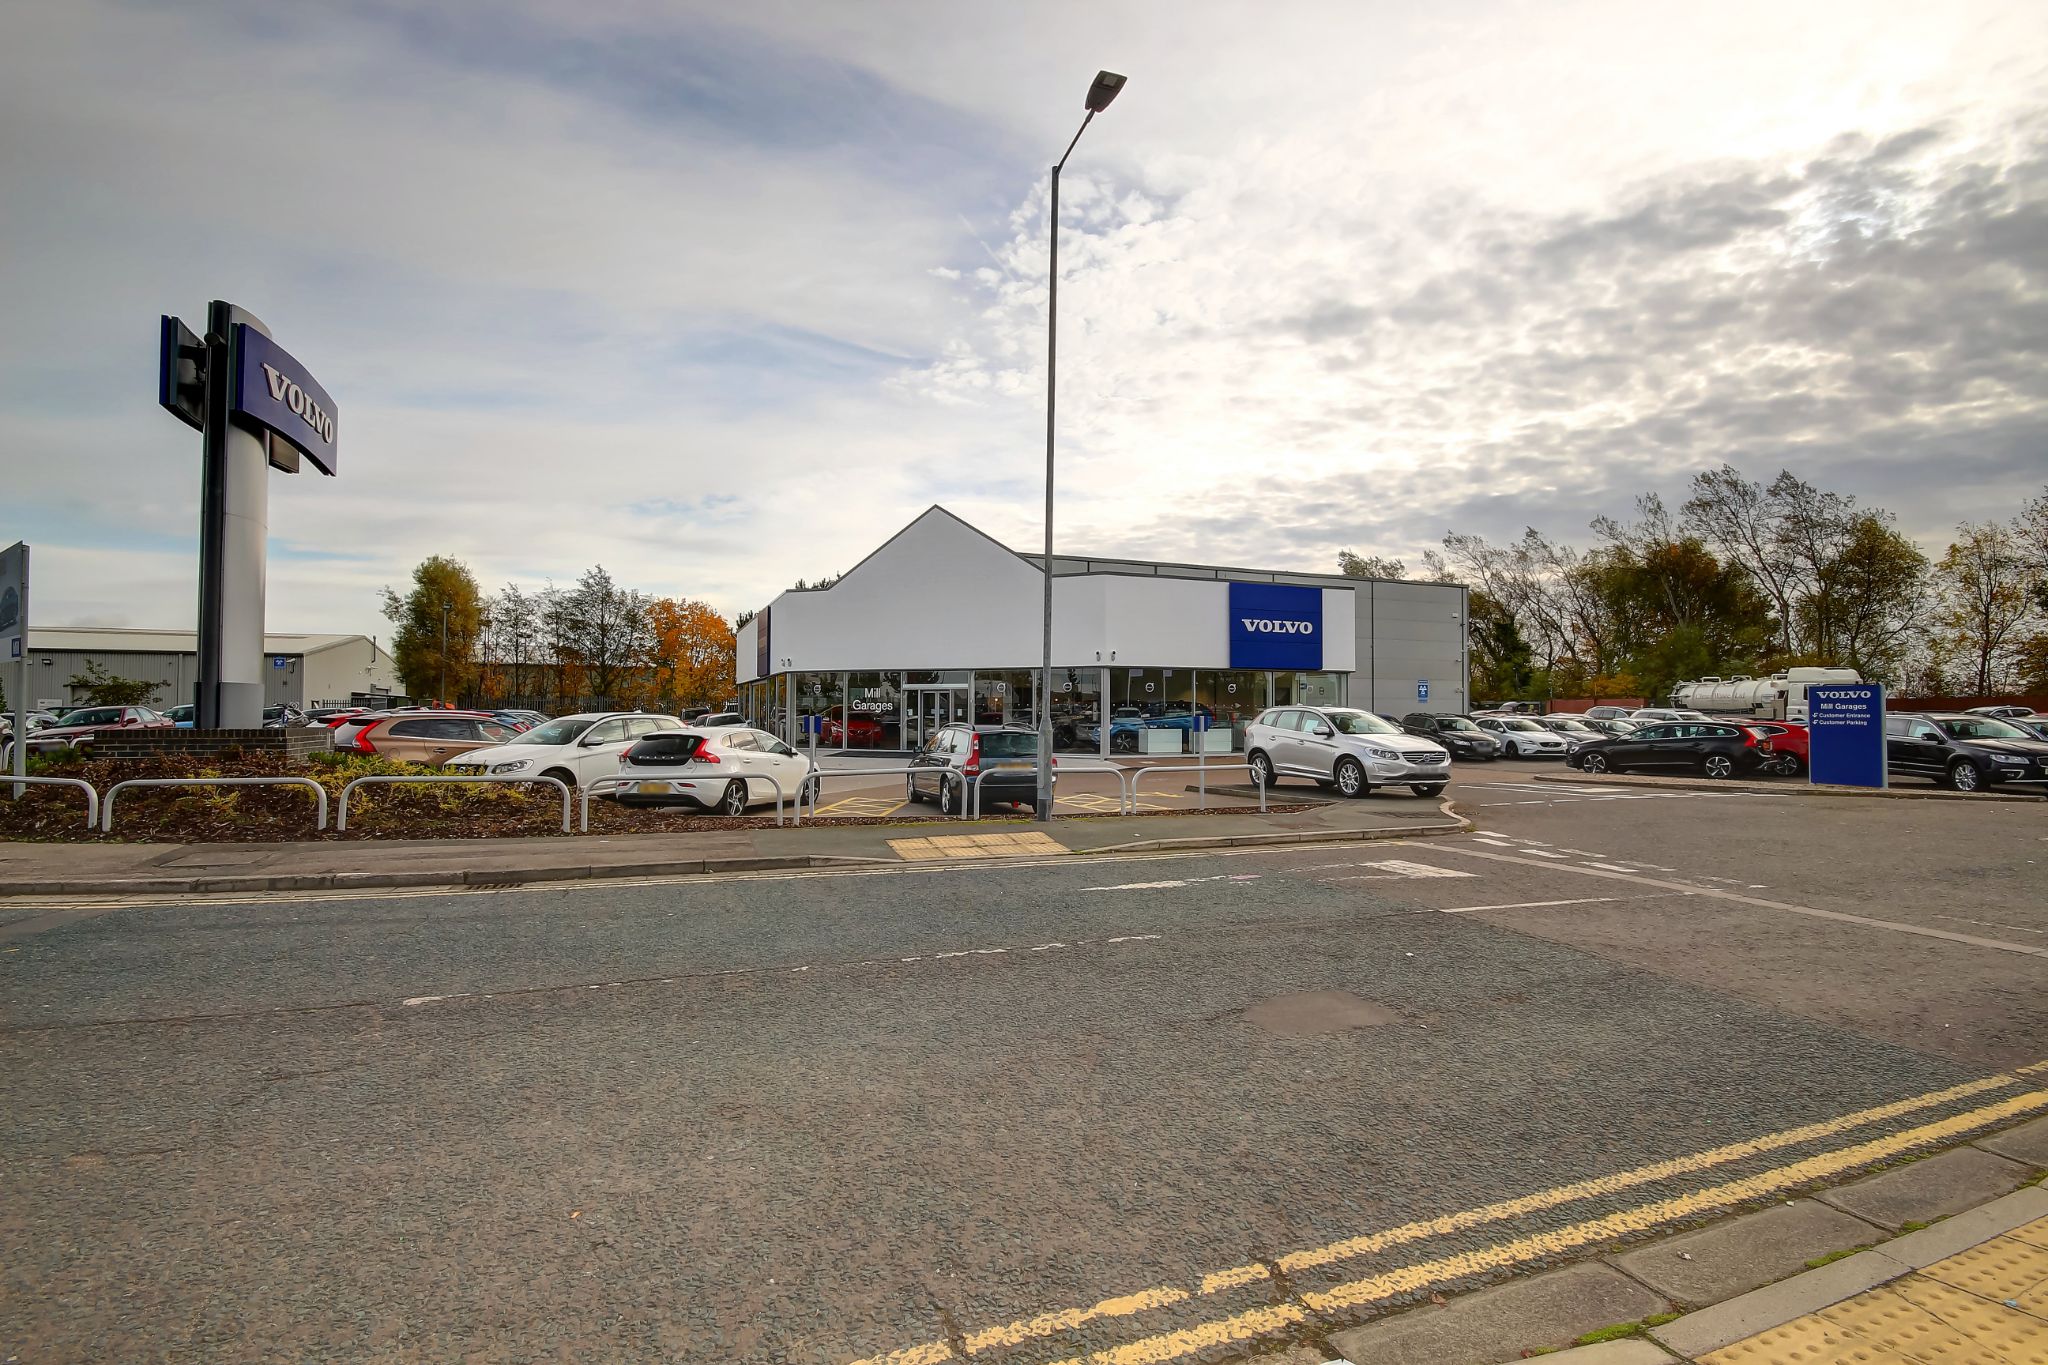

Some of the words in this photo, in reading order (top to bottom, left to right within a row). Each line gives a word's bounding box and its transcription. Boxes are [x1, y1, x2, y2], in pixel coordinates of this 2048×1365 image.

[262, 363, 333, 444] VOLVO
[1241, 618, 1313, 635] VOLVO
[864, 687, 881, 698] Mill
[1816, 690, 1872, 699] VOLVO
[852, 699, 893, 713] Garages
[1835, 703, 1867, 711] Garages
